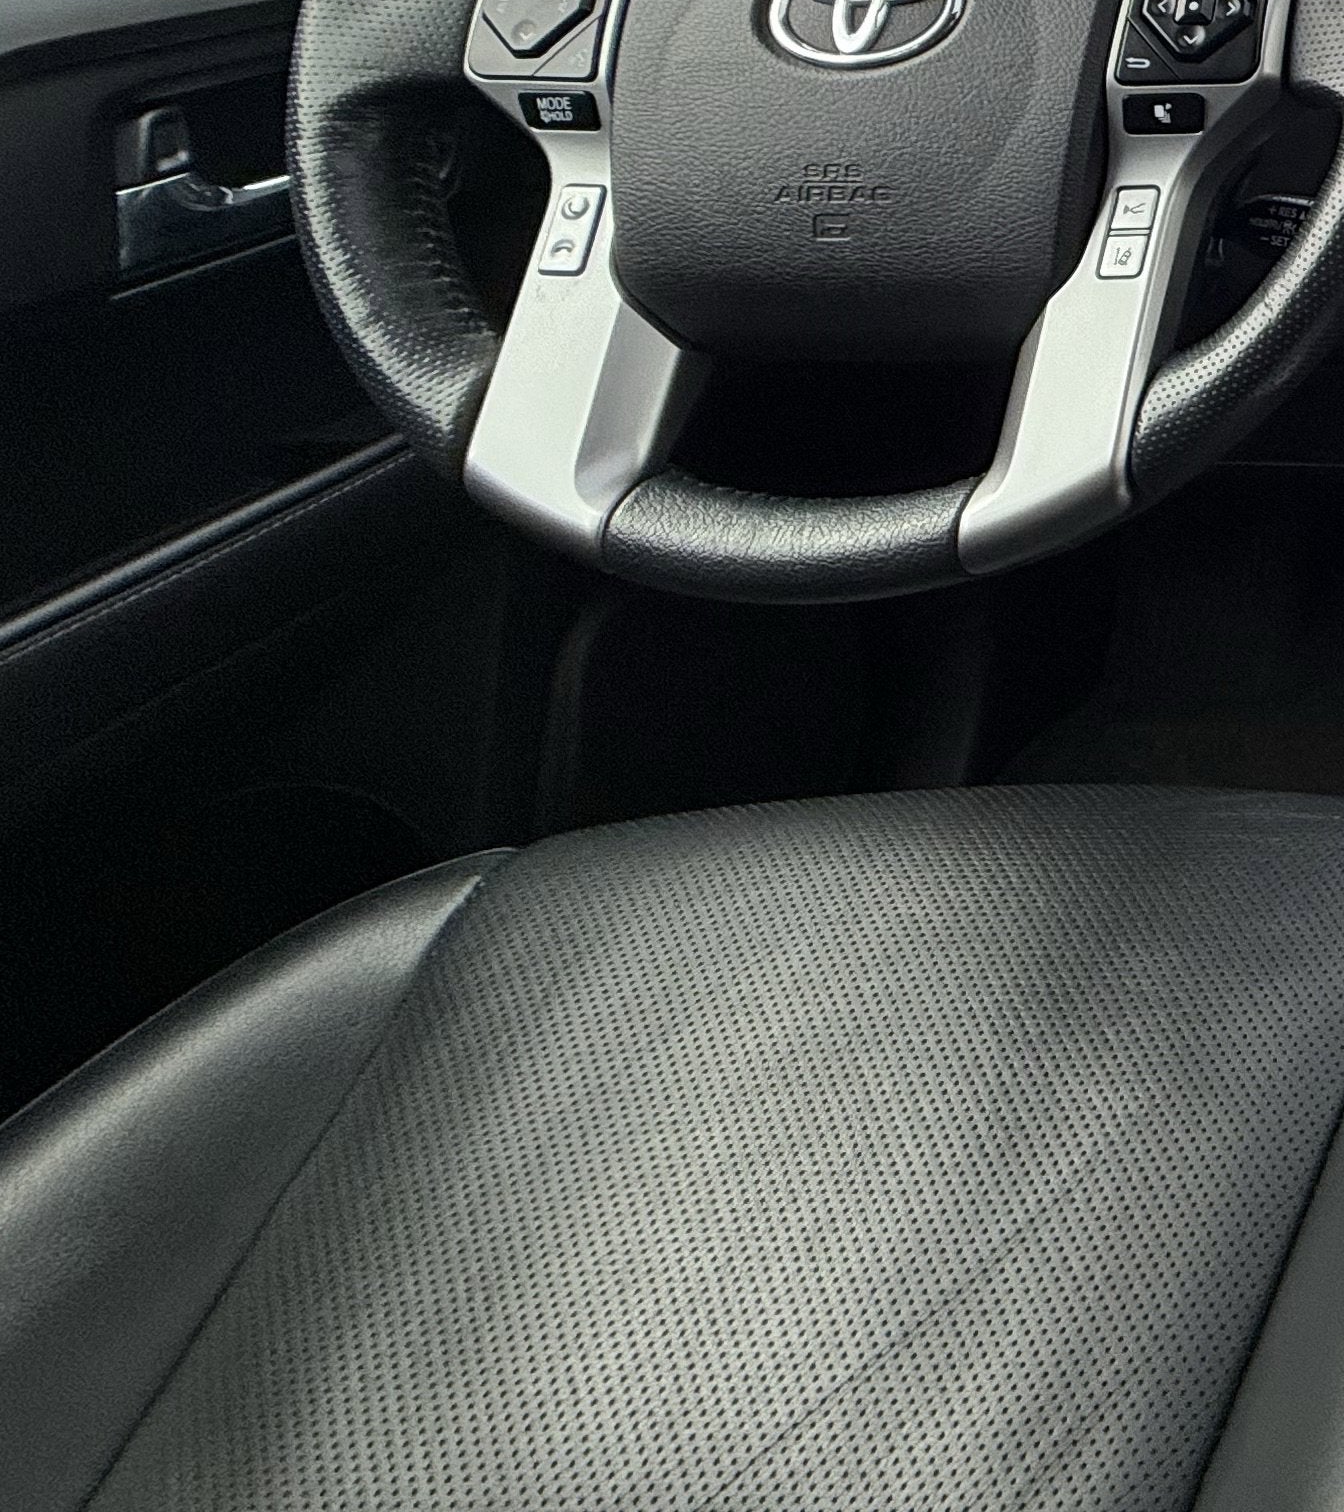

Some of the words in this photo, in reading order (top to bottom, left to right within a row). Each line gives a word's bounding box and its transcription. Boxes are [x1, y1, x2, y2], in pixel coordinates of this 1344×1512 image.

[536, 96, 573, 110] MODE
[803, 163, 864, 180] SRS
[774, 185, 898, 203] AIRBAG
